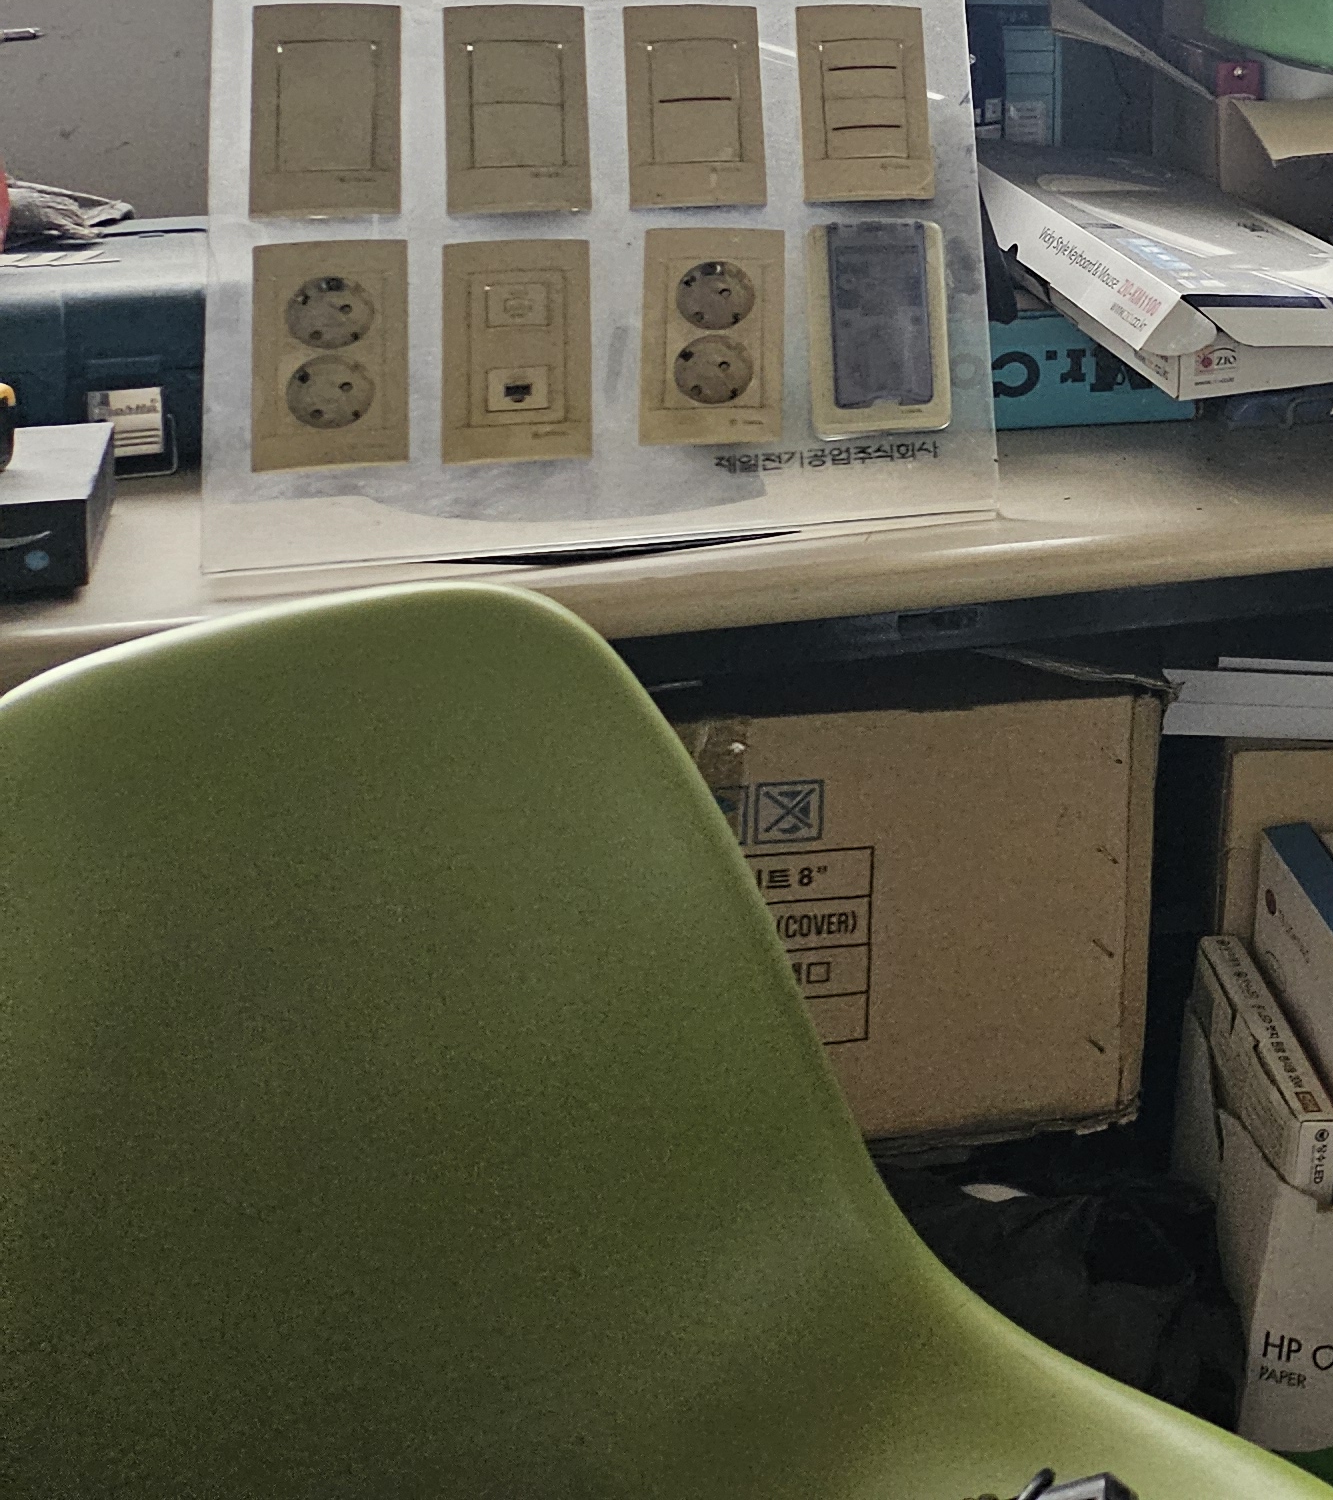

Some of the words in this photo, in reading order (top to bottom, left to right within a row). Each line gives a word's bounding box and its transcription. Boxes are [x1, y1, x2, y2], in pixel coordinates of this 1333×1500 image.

[1065, 246, 1098, 276] Keyboard
[1098, 265, 1120, 290] Mouse
[1214, 354, 1237, 367] ZIO
[776, 910, 857, 939] (COVER)
[1262, 1330, 1303, 1362] HP
[1259, 1365, 1307, 1389] PAPER
